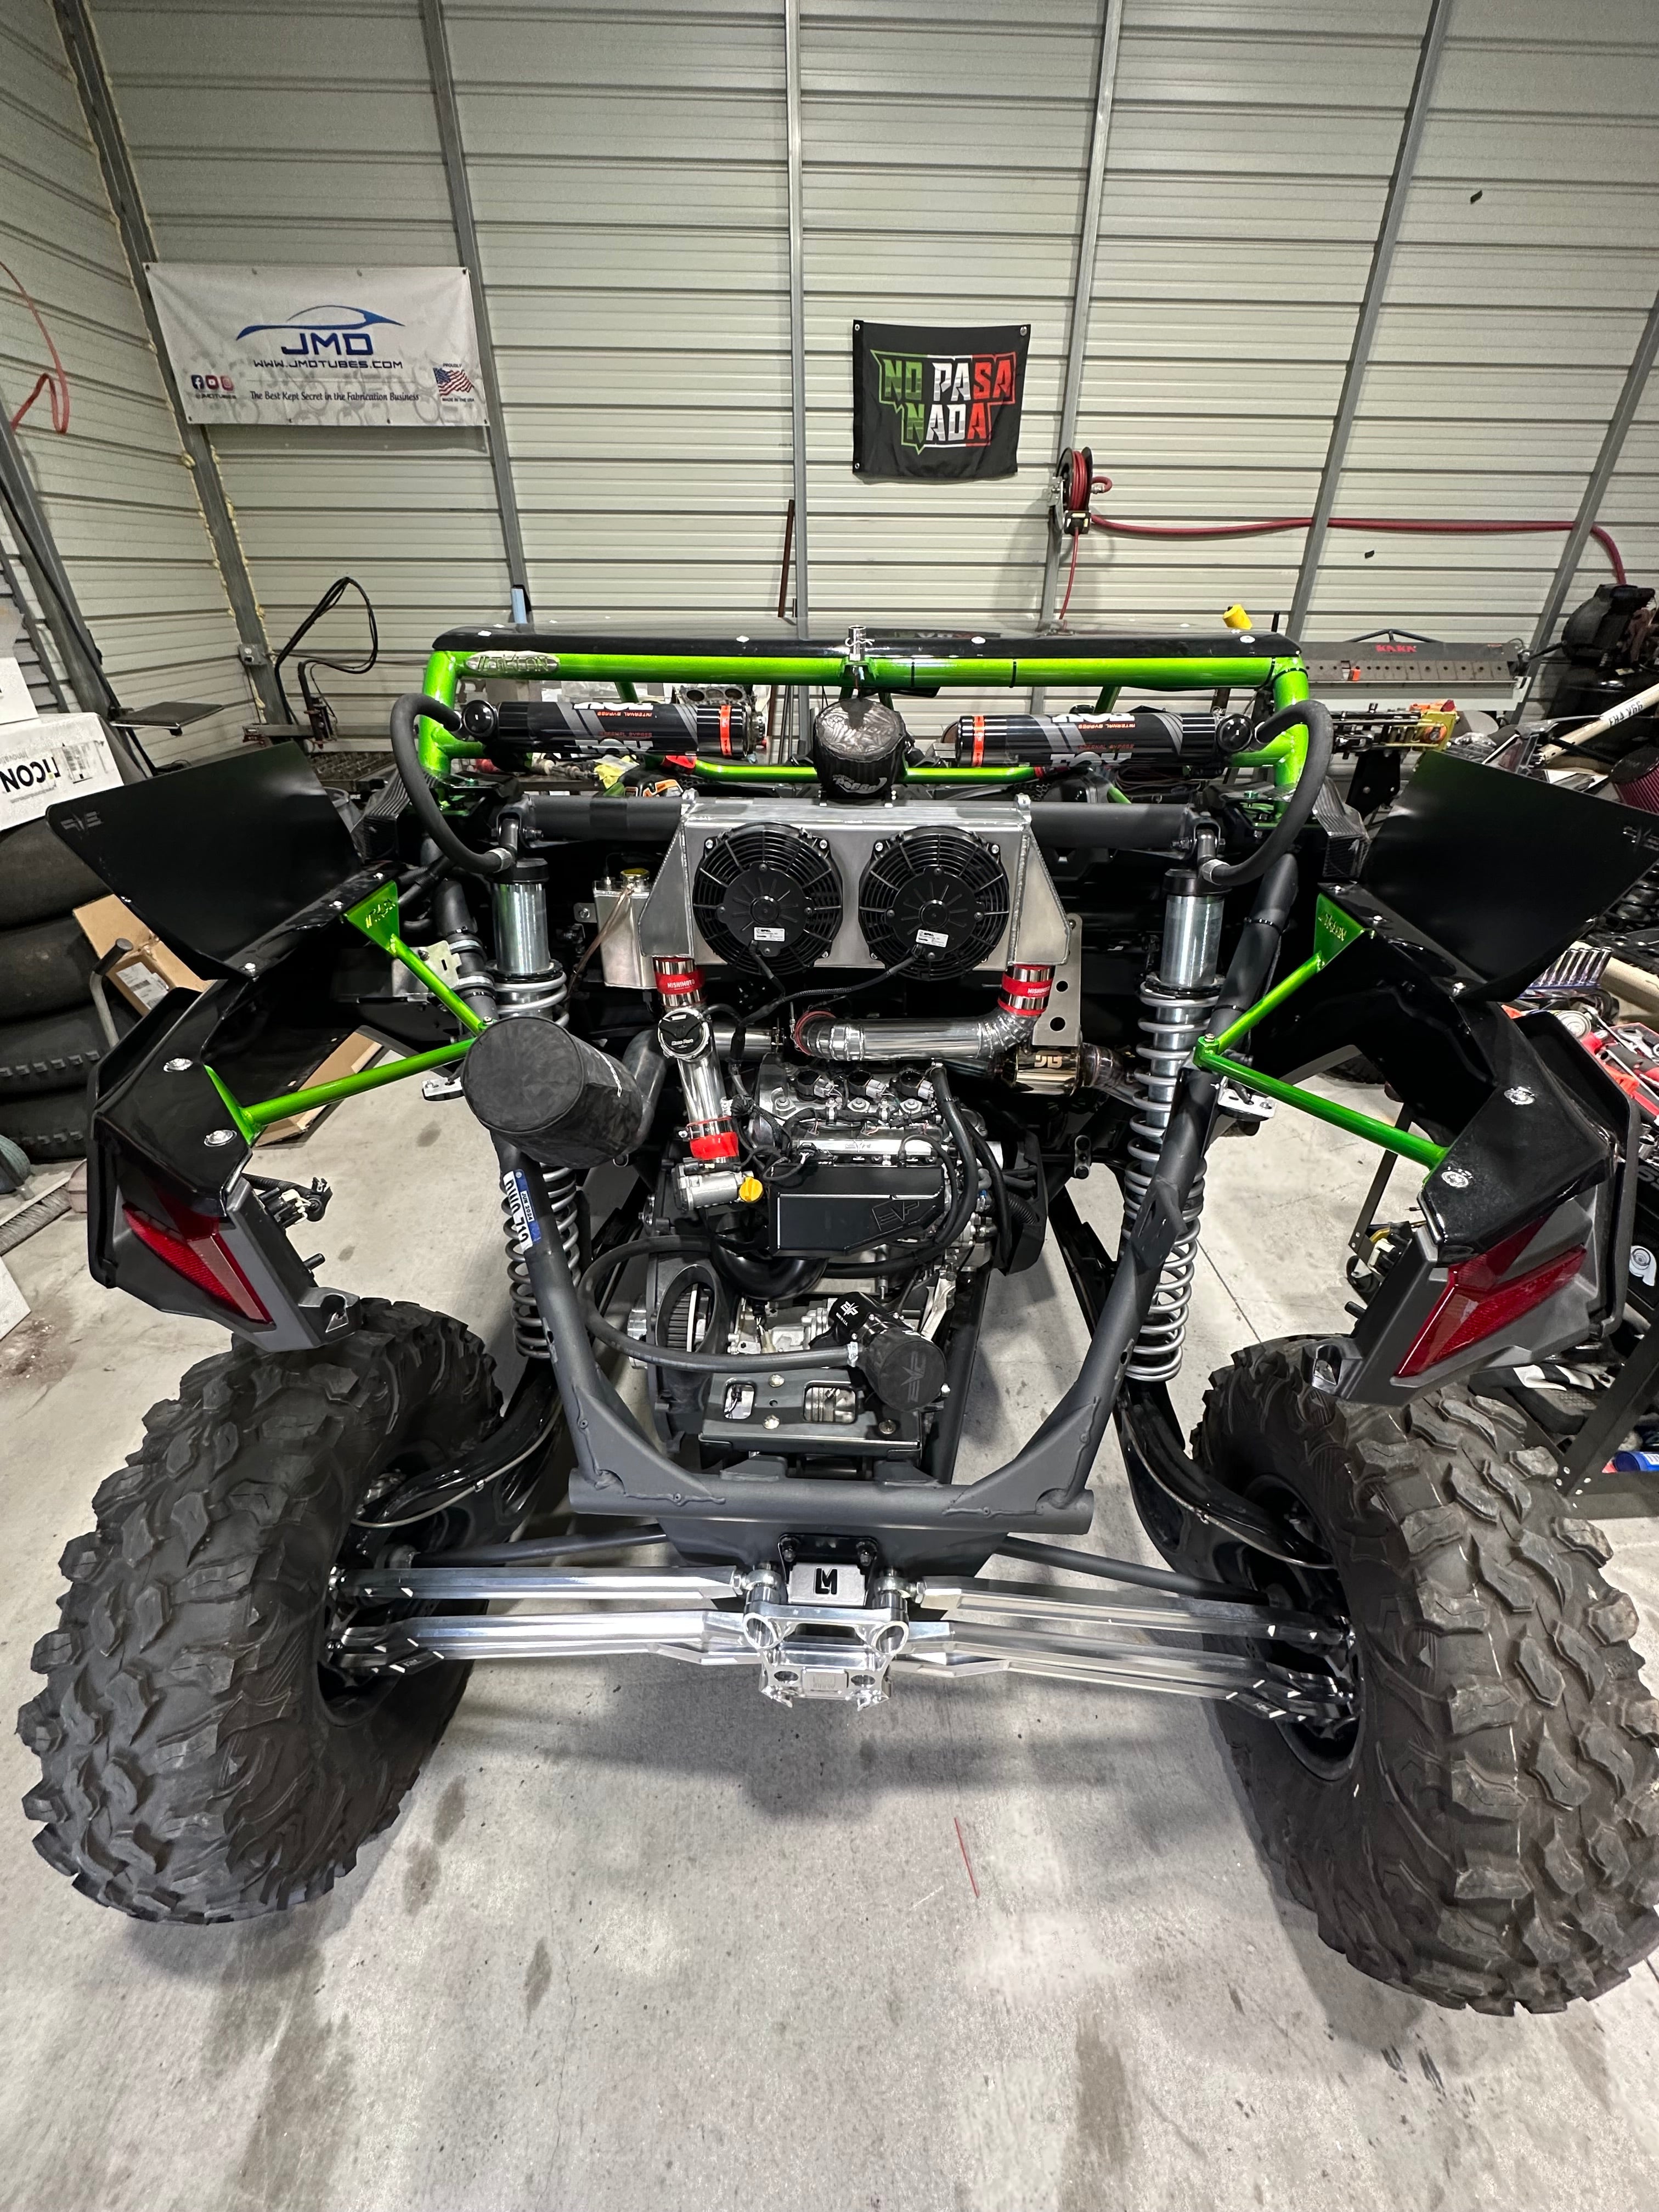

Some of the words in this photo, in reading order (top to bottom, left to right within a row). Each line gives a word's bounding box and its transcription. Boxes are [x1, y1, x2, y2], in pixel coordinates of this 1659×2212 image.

[281, 332, 374, 356] JMD
[253, 359, 403, 369] WWW.JMDTUBES.COM
[883, 358, 923, 401] NO
[932, 359, 1012, 402] PASA
[250, 391, 263, 399] The
[264, 391, 280, 400] Best
[282, 391, 299, 402] Kept
[301, 391, 323, 401] Secret
[325, 392, 332, 400] in
[334, 392, 346, 400] the
[347, 392, 388, 401] Fabrication
[390, 392, 419, 402] Business
[905, 402, 987, 443] NADA
[667, 979, 695, 989] MISHIMOTO
[525, 1205, 533, 1221] 2024
